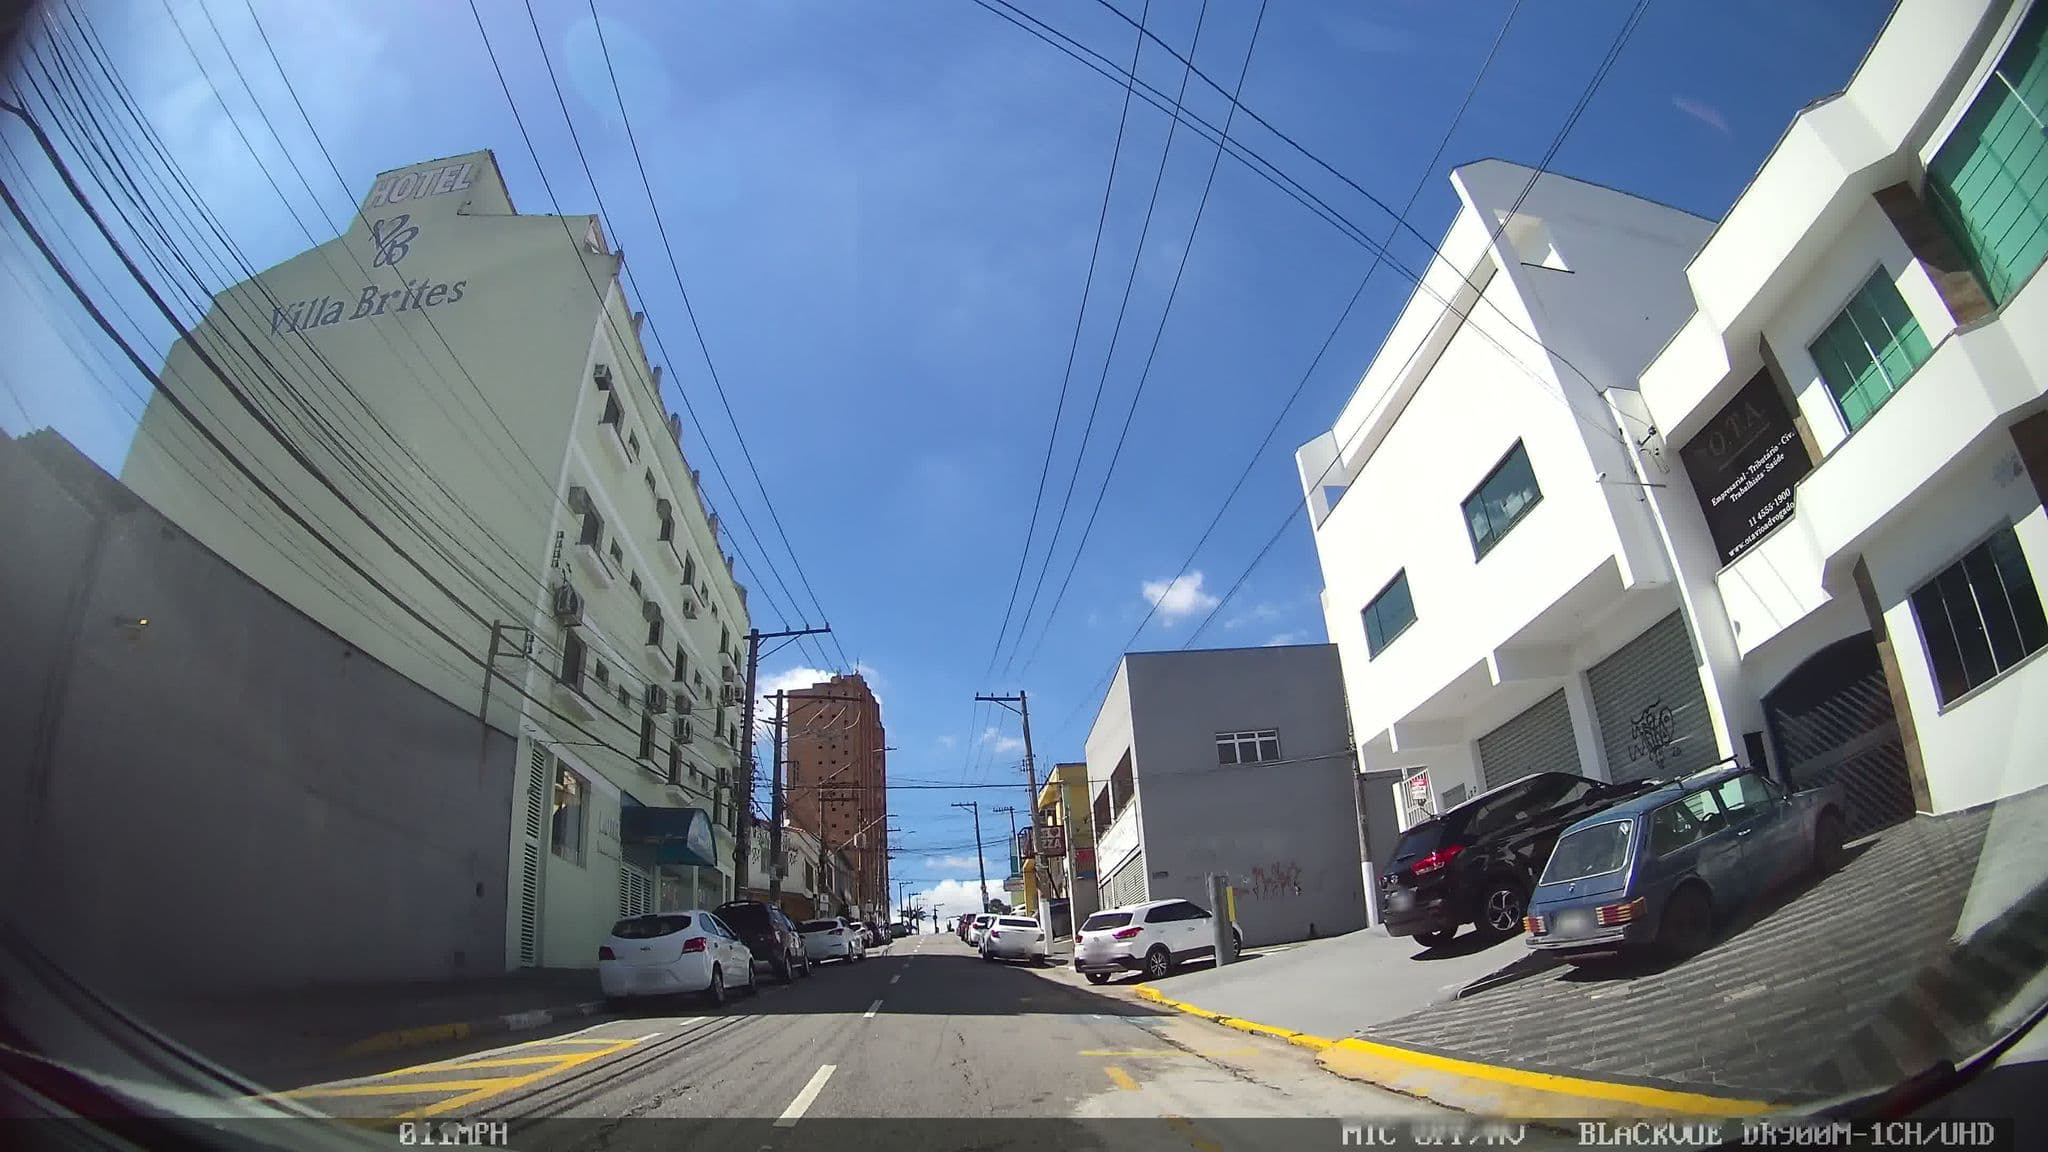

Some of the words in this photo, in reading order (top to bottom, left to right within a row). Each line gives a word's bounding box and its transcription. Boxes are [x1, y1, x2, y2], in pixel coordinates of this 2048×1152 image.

[367, 163, 472, 209] HOTEL
[271, 296, 345, 336] Villa
[349, 277, 467, 321] Brites
[1711, 472, 1747, 506] Empresarial
[1748, 445, 1779, 474] Tributário
[1730, 472, 1765, 502] Trabalhista
[1765, 453, 1785, 472] Saúde
[1748, 516, 1758, 528] 11
[1757, 487, 1791, 521] 4555-1900
